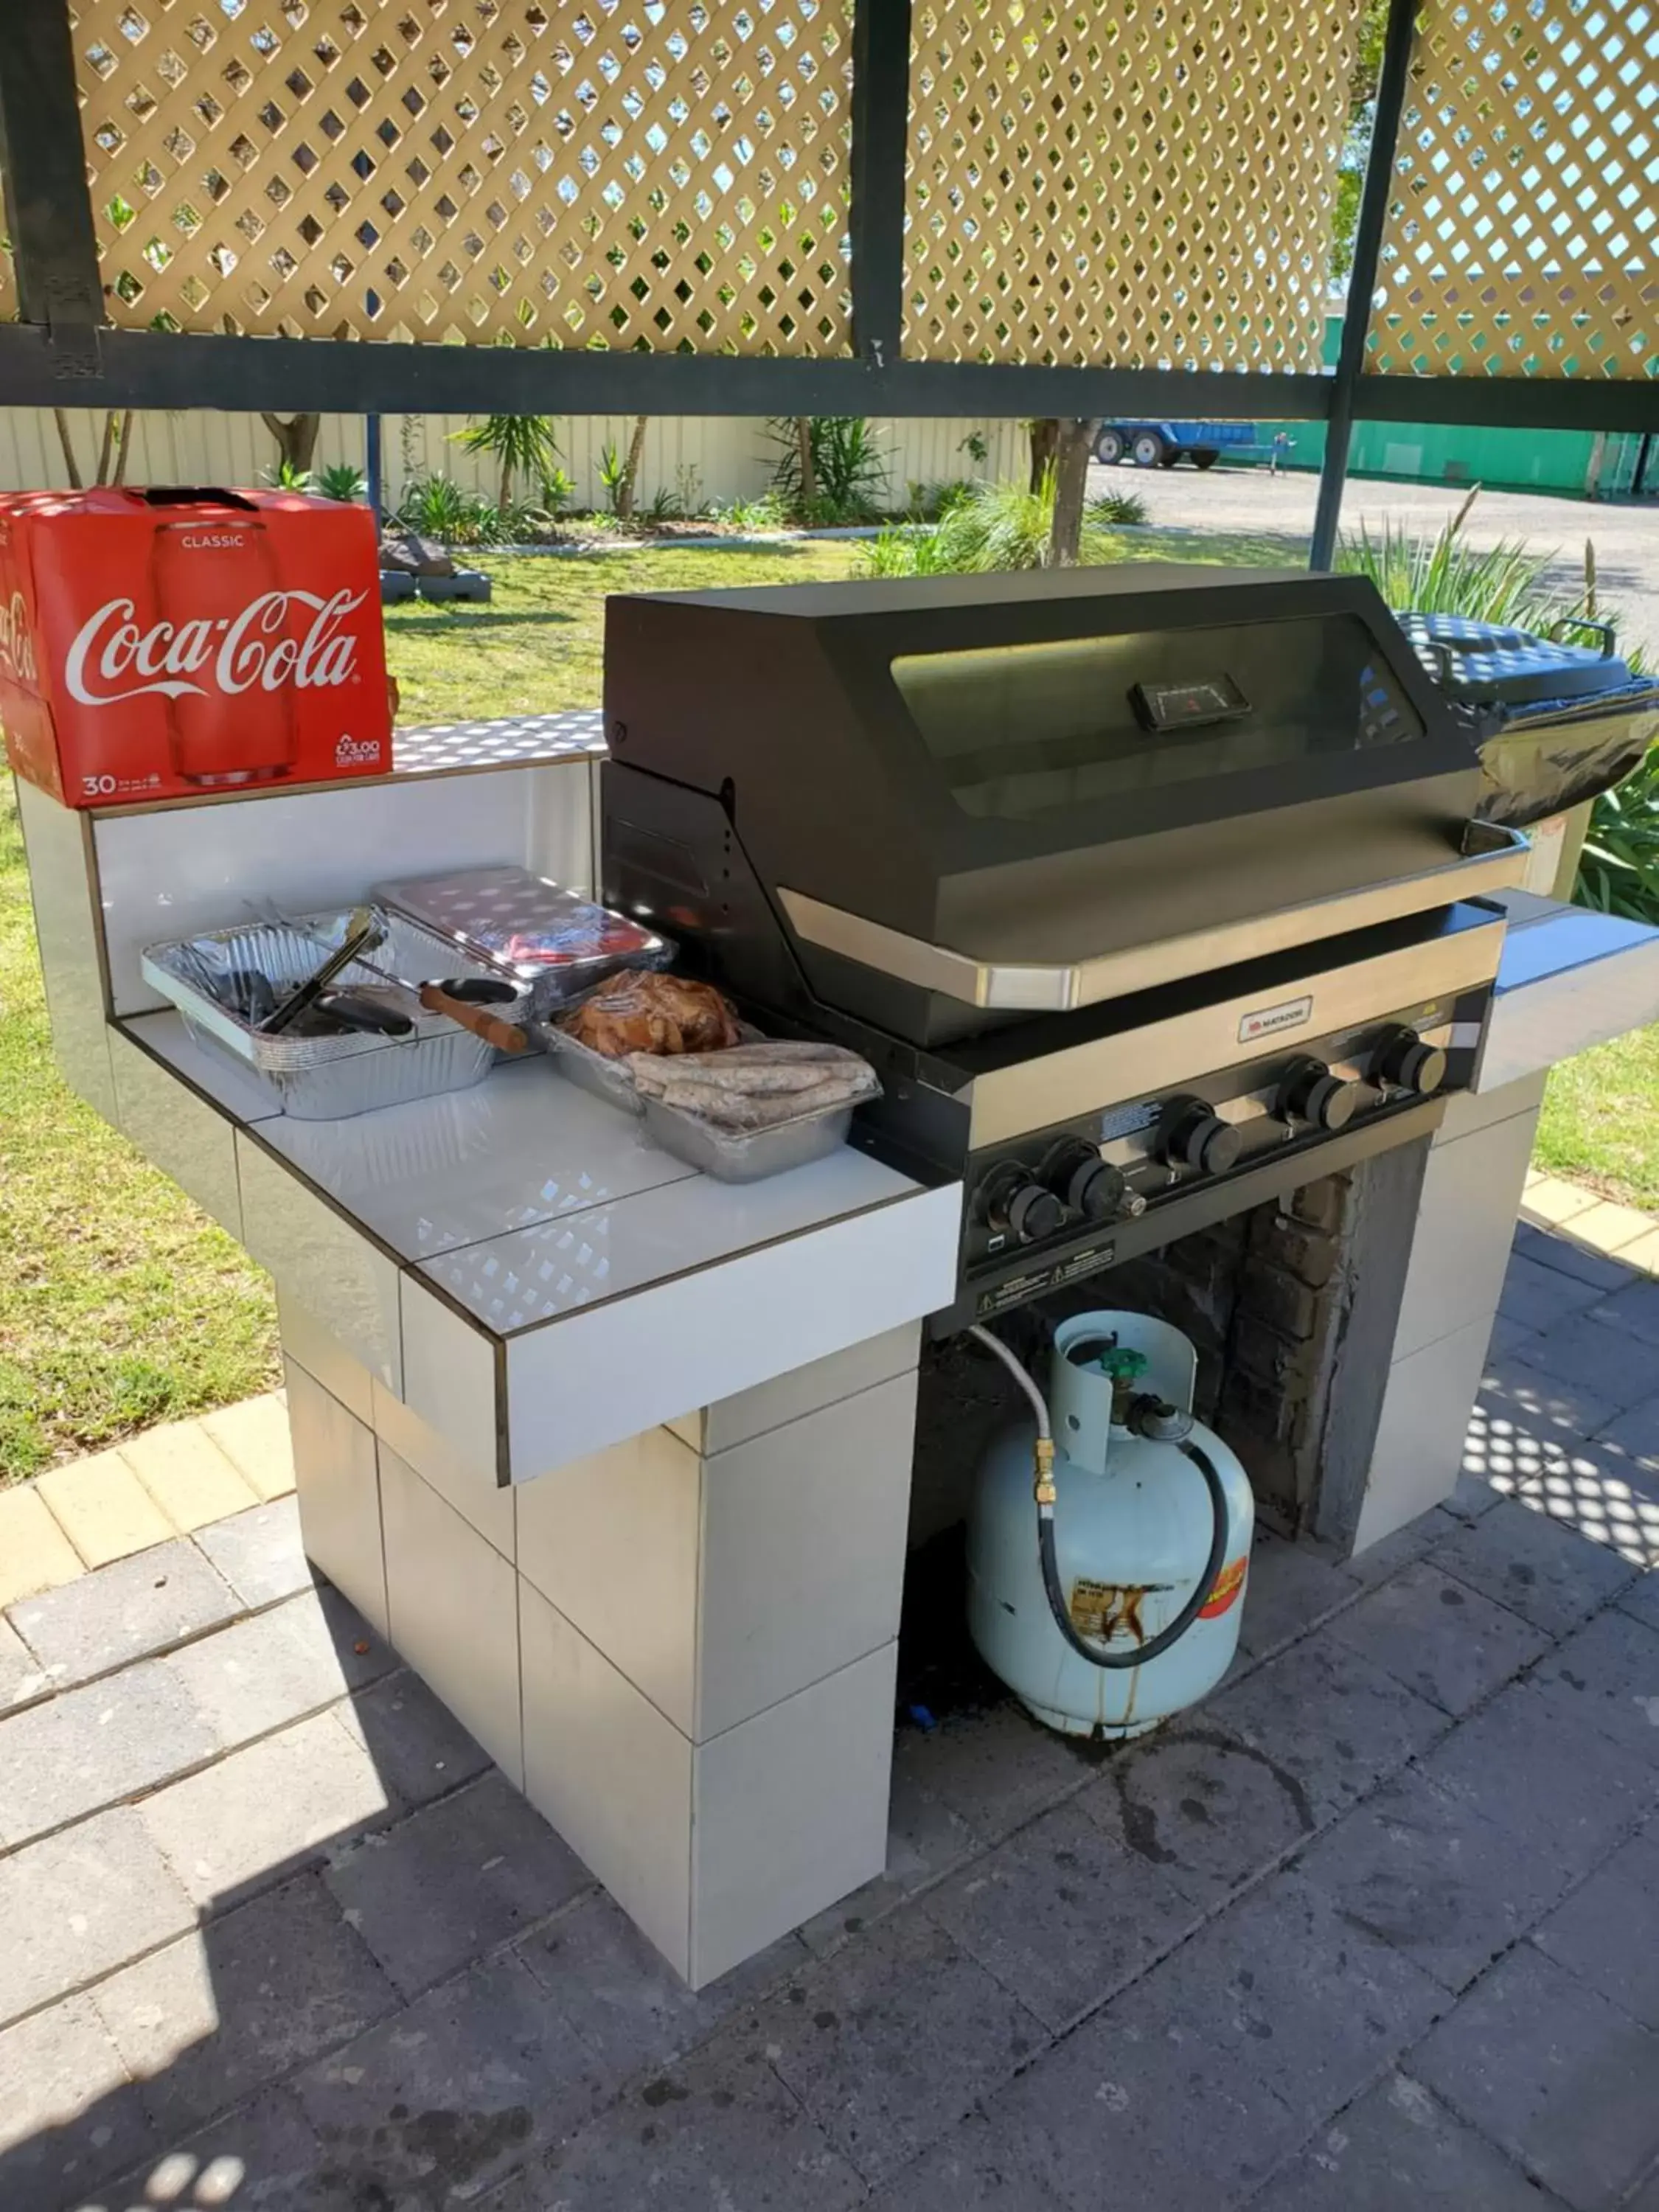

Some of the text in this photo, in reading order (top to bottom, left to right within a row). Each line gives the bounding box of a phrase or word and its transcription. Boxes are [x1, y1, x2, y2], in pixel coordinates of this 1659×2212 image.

[181, 535, 245, 548] CLASSIC
[65, 588, 370, 706] Coca-Cola
[83, 774, 116, 796] 30
